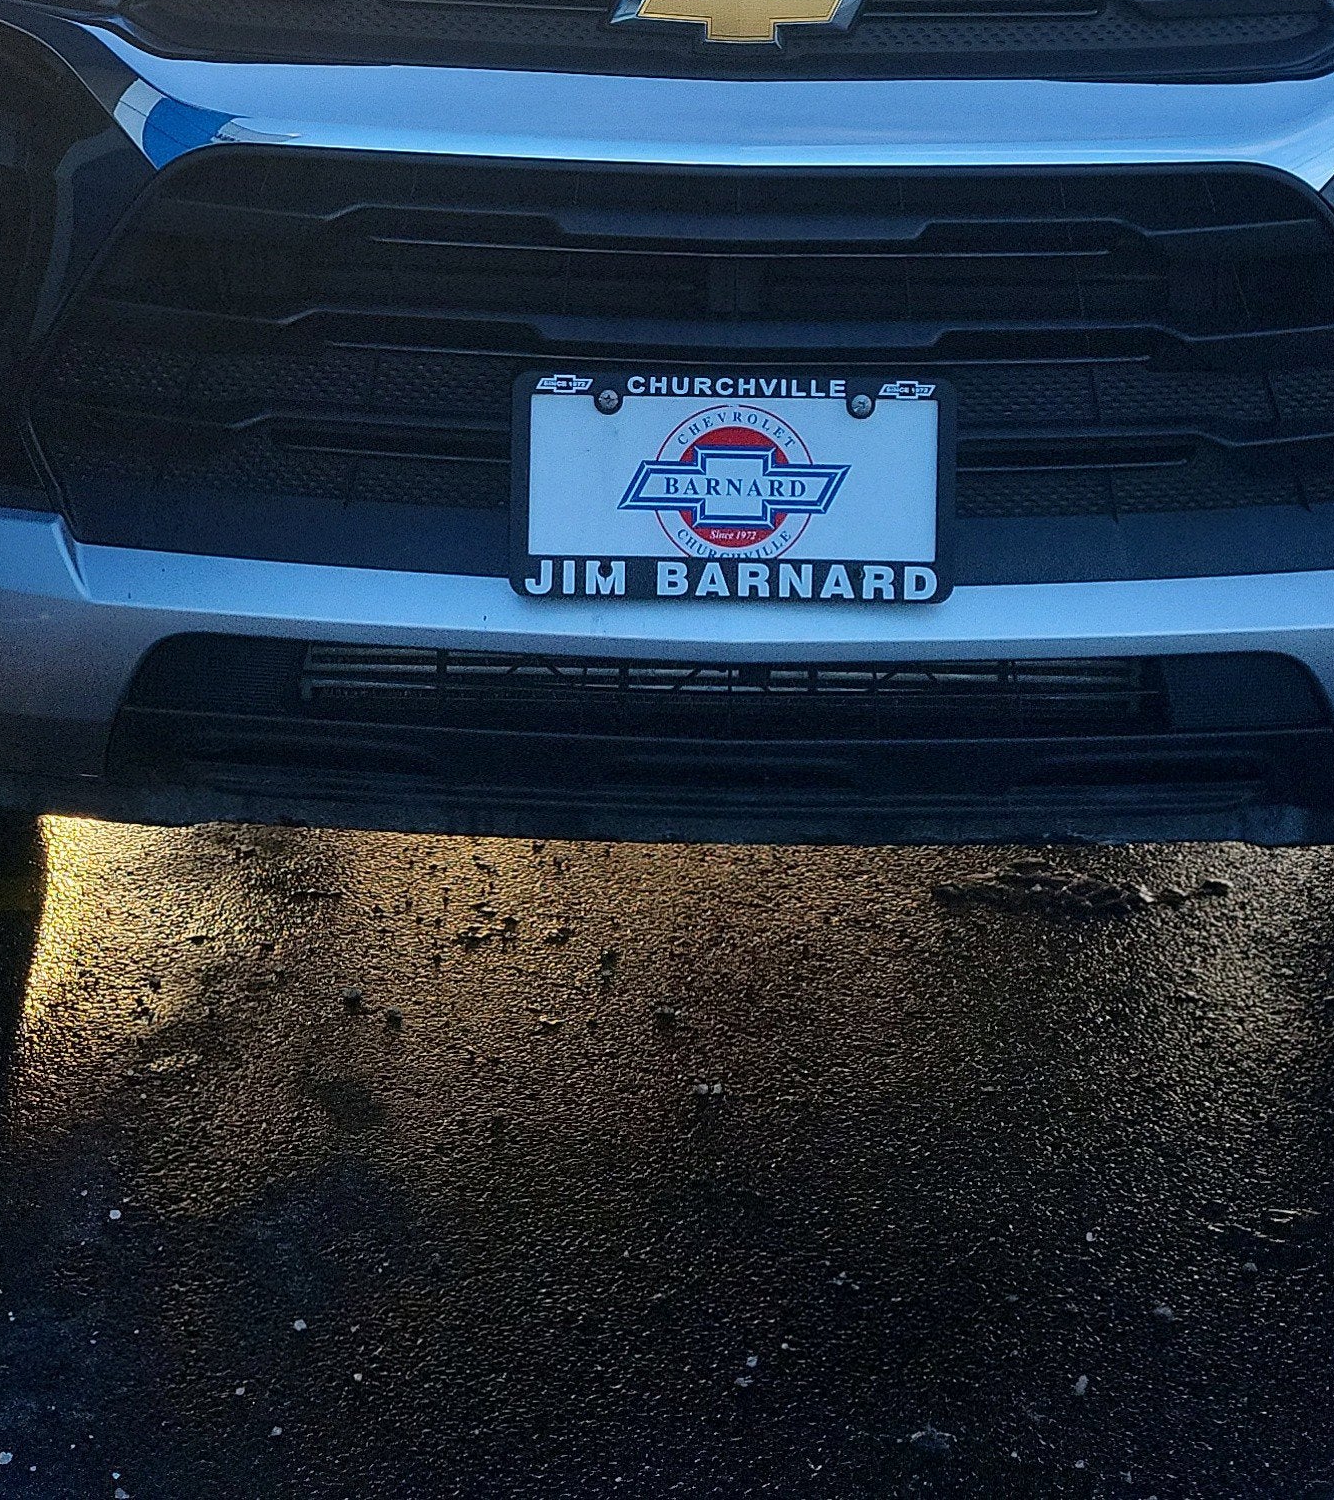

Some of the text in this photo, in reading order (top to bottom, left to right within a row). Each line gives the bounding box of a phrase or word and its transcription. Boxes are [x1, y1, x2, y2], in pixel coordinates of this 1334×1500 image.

[626, 375, 847, 397] CHURCHVILLE
[677, 411, 796, 448] CHEVROLET
[664, 476, 807, 498] BARNARD
[709, 529, 757, 541] Since 1972
[524, 560, 938, 601] JIM BARNARD
